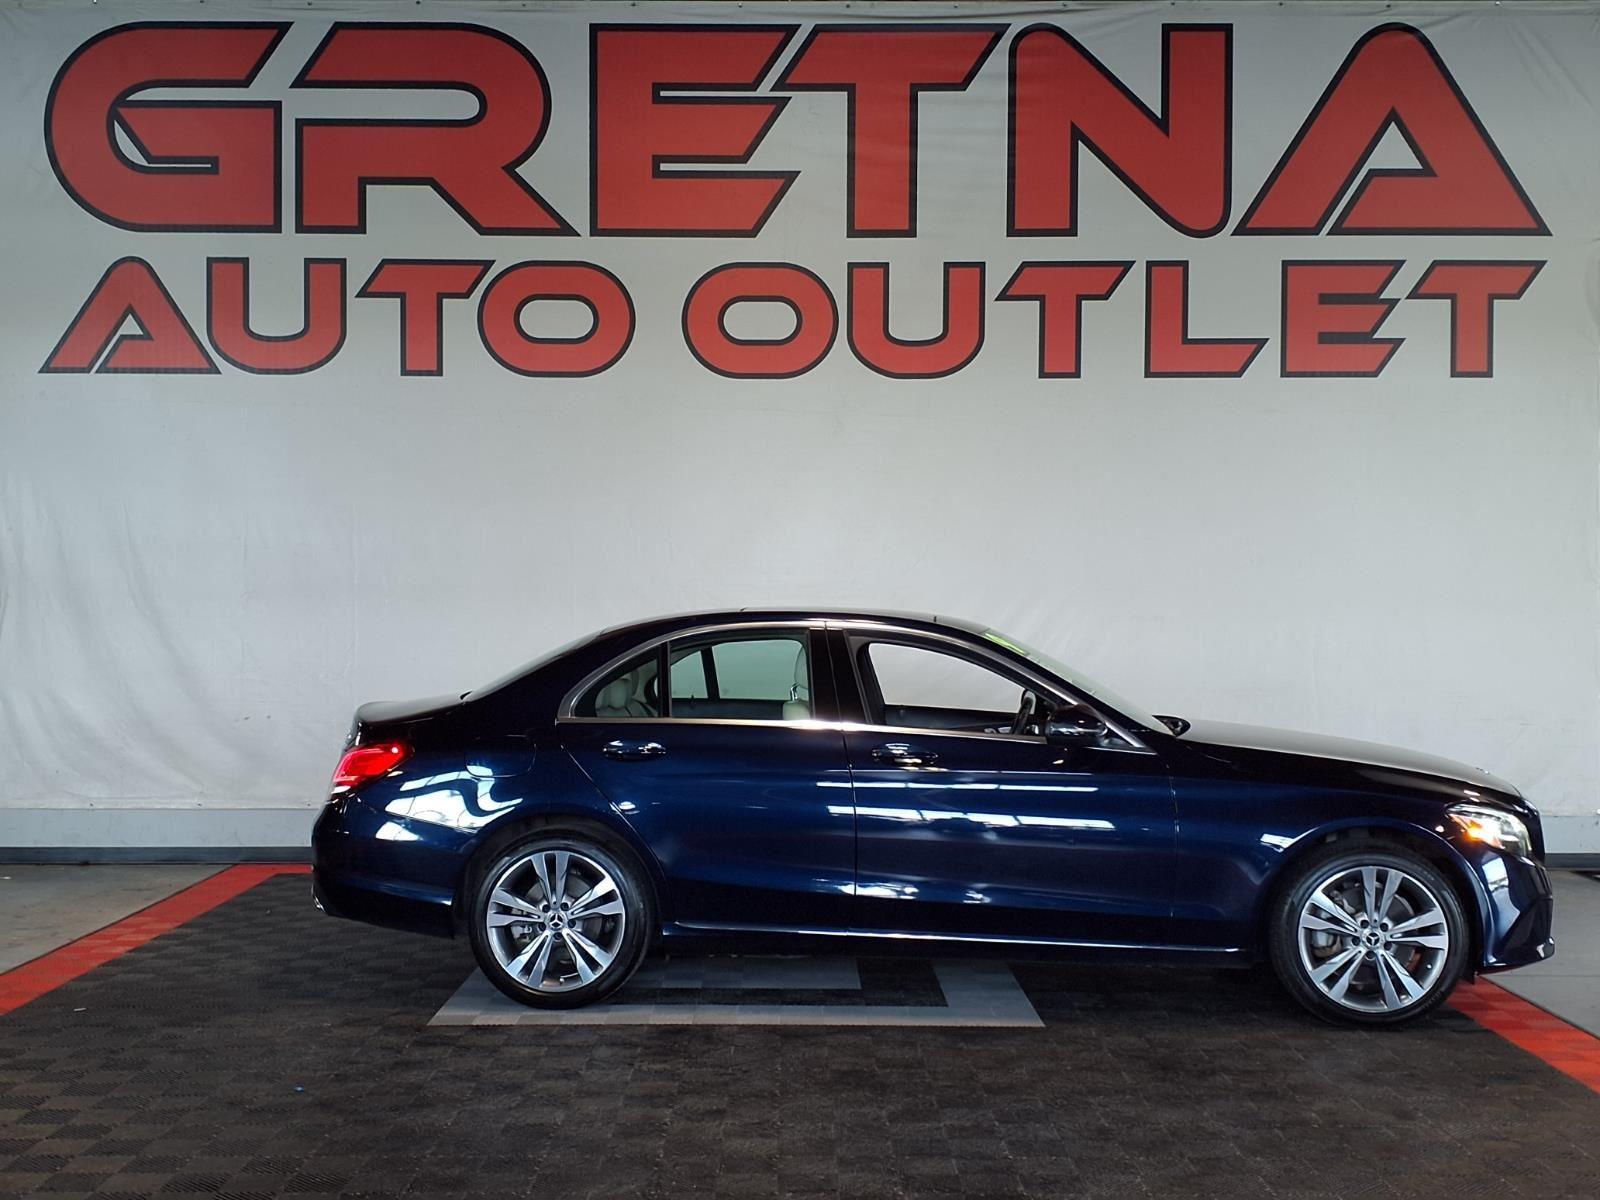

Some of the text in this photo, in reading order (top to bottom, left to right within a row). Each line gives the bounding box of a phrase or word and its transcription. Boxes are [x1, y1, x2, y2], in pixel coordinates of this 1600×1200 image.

[44, 21, 1552, 238] GRETNA
[38, 256, 1547, 379] AUTO OUTLET
